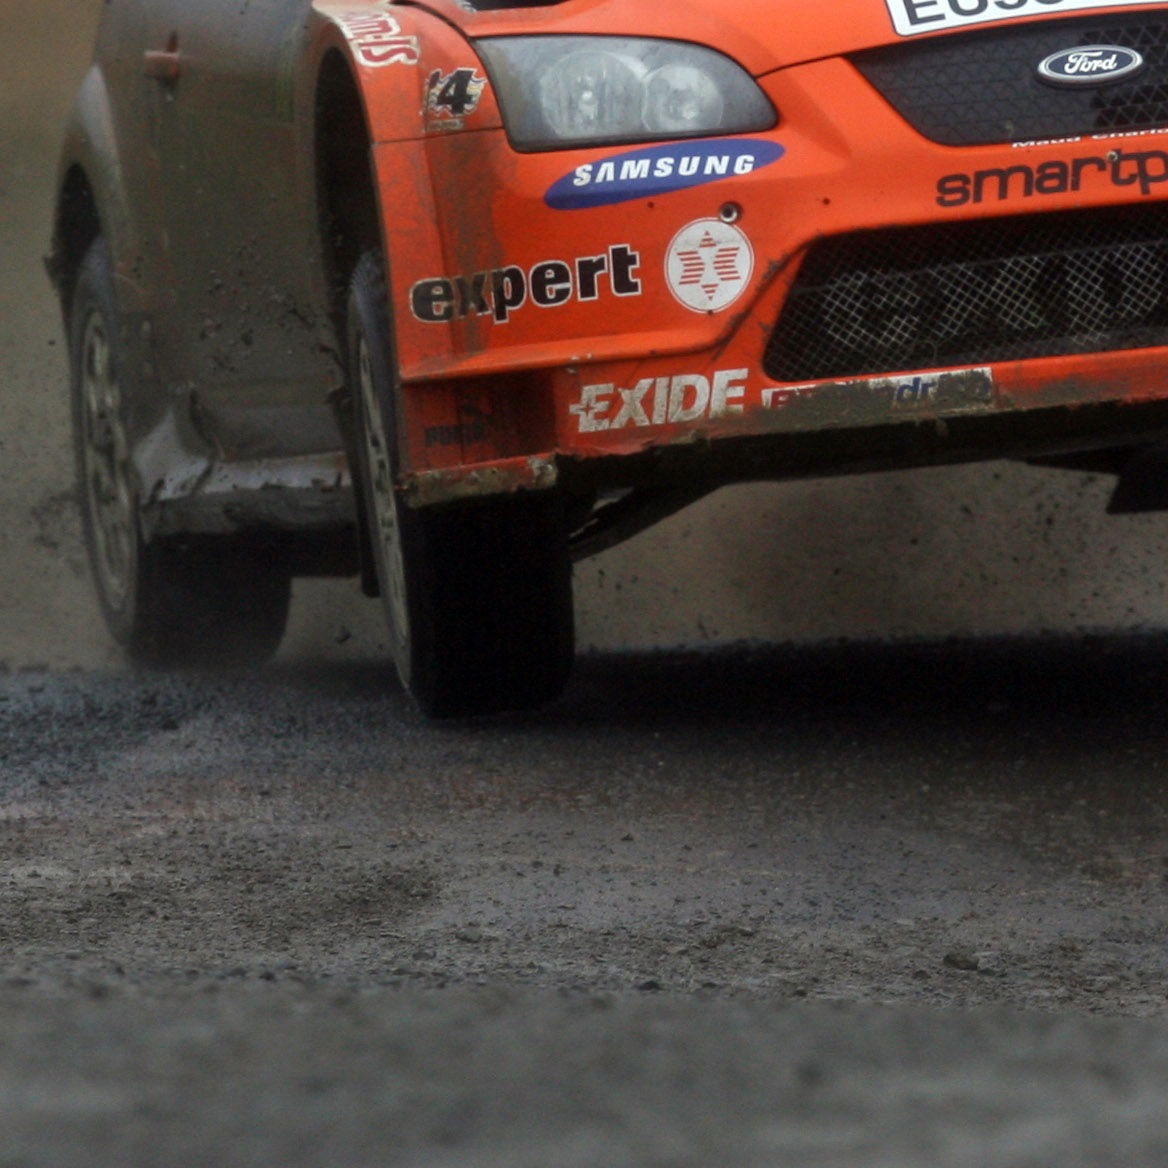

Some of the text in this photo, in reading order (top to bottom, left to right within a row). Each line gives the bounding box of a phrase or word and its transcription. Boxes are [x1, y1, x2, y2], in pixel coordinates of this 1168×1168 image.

[1063, 51, 1118, 74] Ford
[573, 154, 755, 187] SAMSUNG
[409, 244, 641, 324] expert
[570, 368, 749, 433] EXIDE
